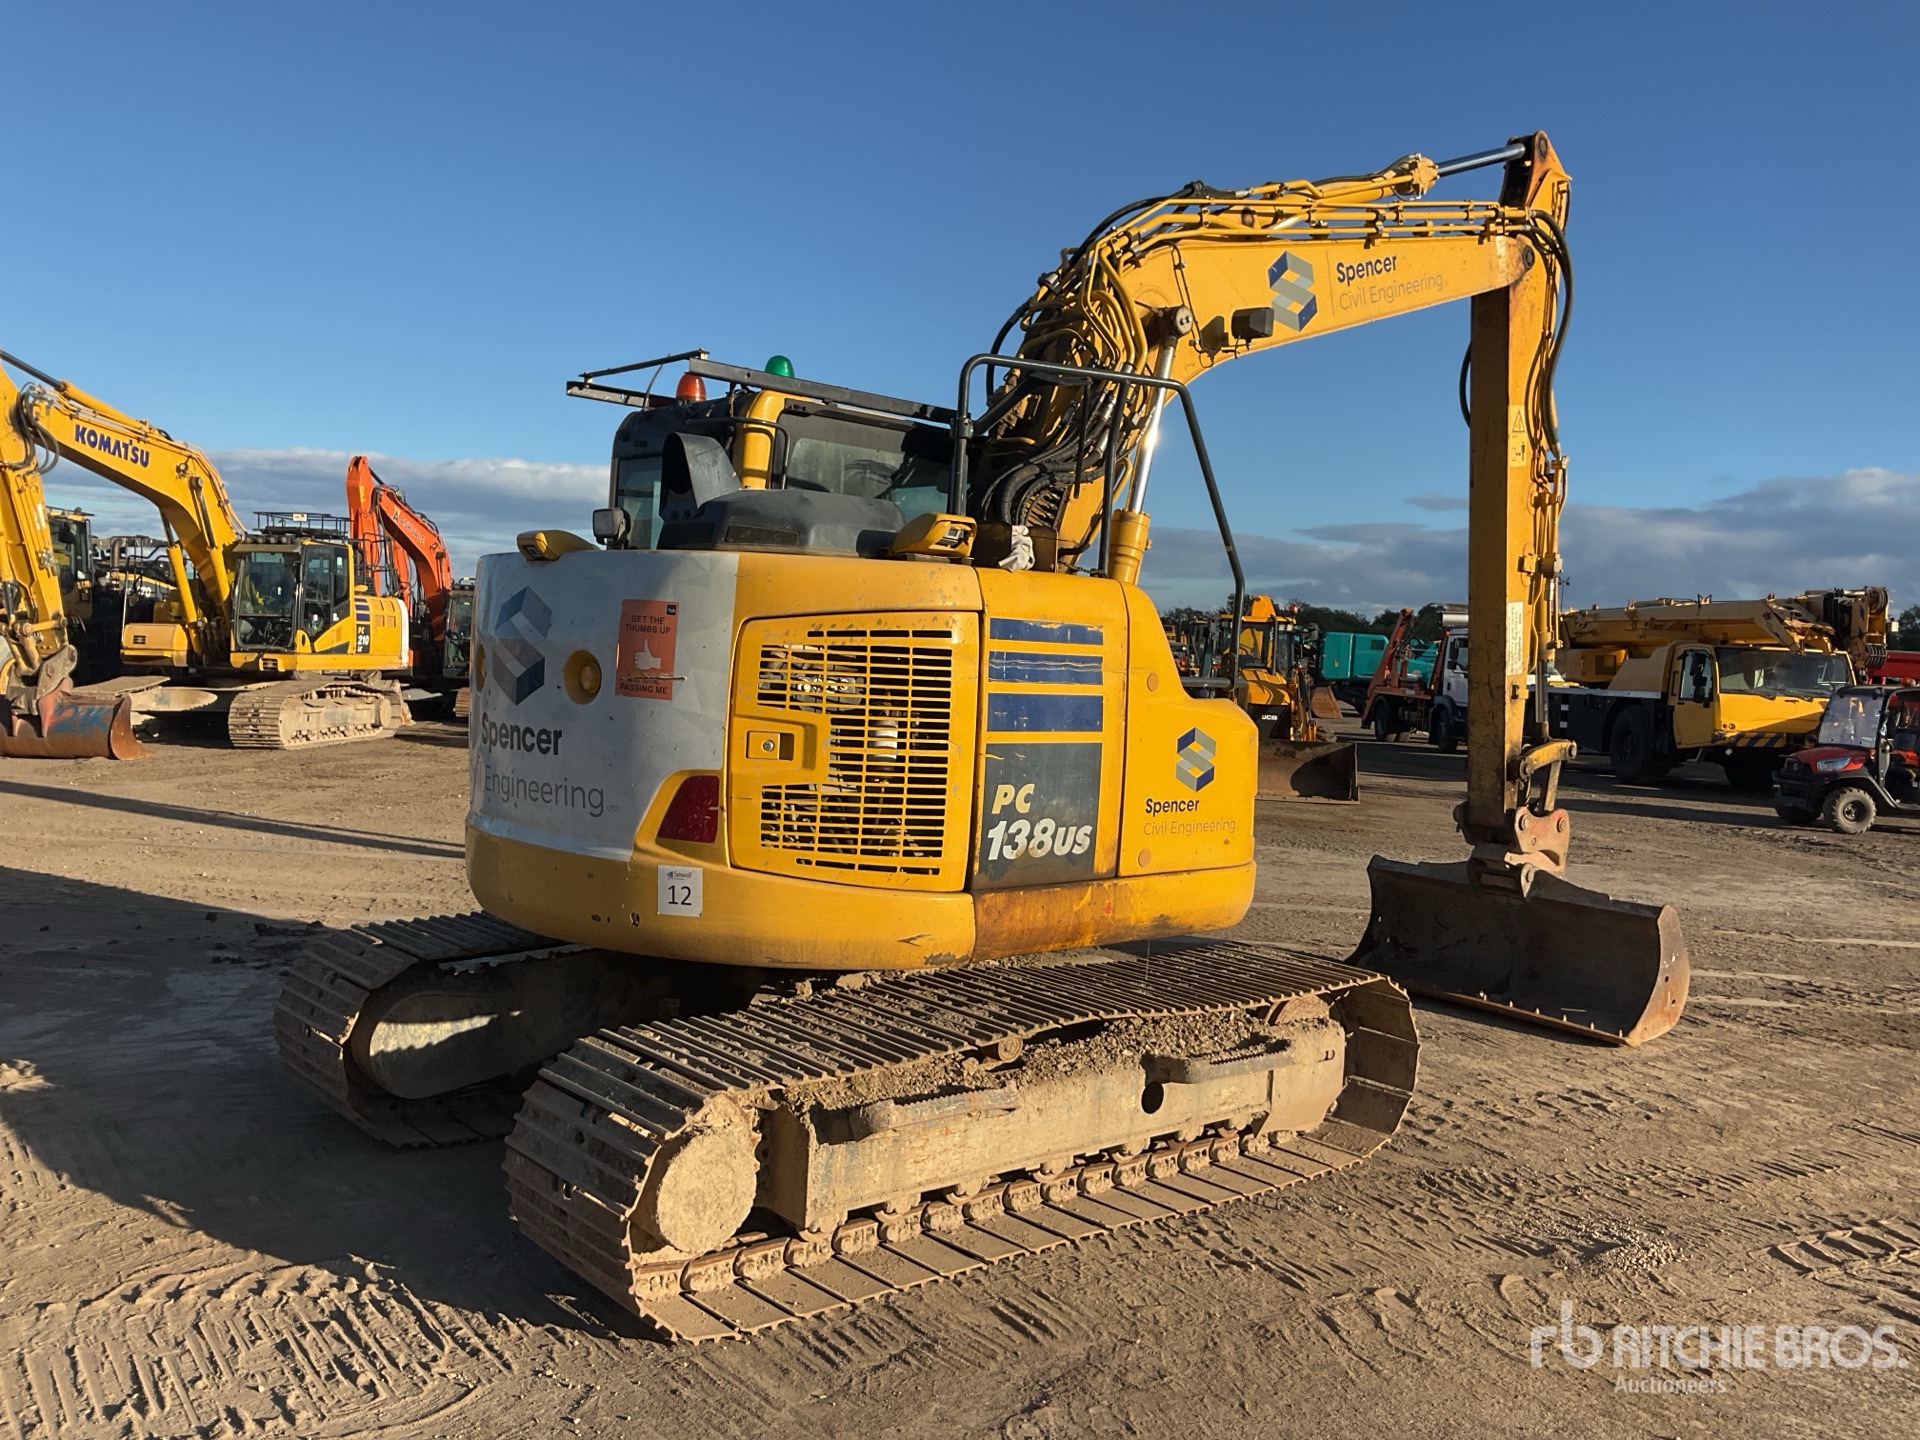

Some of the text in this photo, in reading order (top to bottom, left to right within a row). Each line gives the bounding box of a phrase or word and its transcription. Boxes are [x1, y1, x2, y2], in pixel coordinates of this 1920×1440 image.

[1336, 254, 1398, 286] Spencer
[1339, 273, 1442, 310] Civil Engineering
[75, 424, 150, 468] KOMATSU
[625, 623, 671, 635] THUMBS UP
[631, 614, 665, 625] GET THE
[357, 634, 370, 646] 210
[620, 683, 668, 695] PASSING ME
[481, 712, 563, 755] Spencer
[484, 765, 604, 817] Engineering
[991, 783, 1035, 815] PC
[1145, 797, 1200, 816] Spencer
[1143, 817, 1237, 837] Civil Engineering
[667, 884, 692, 906] 12
